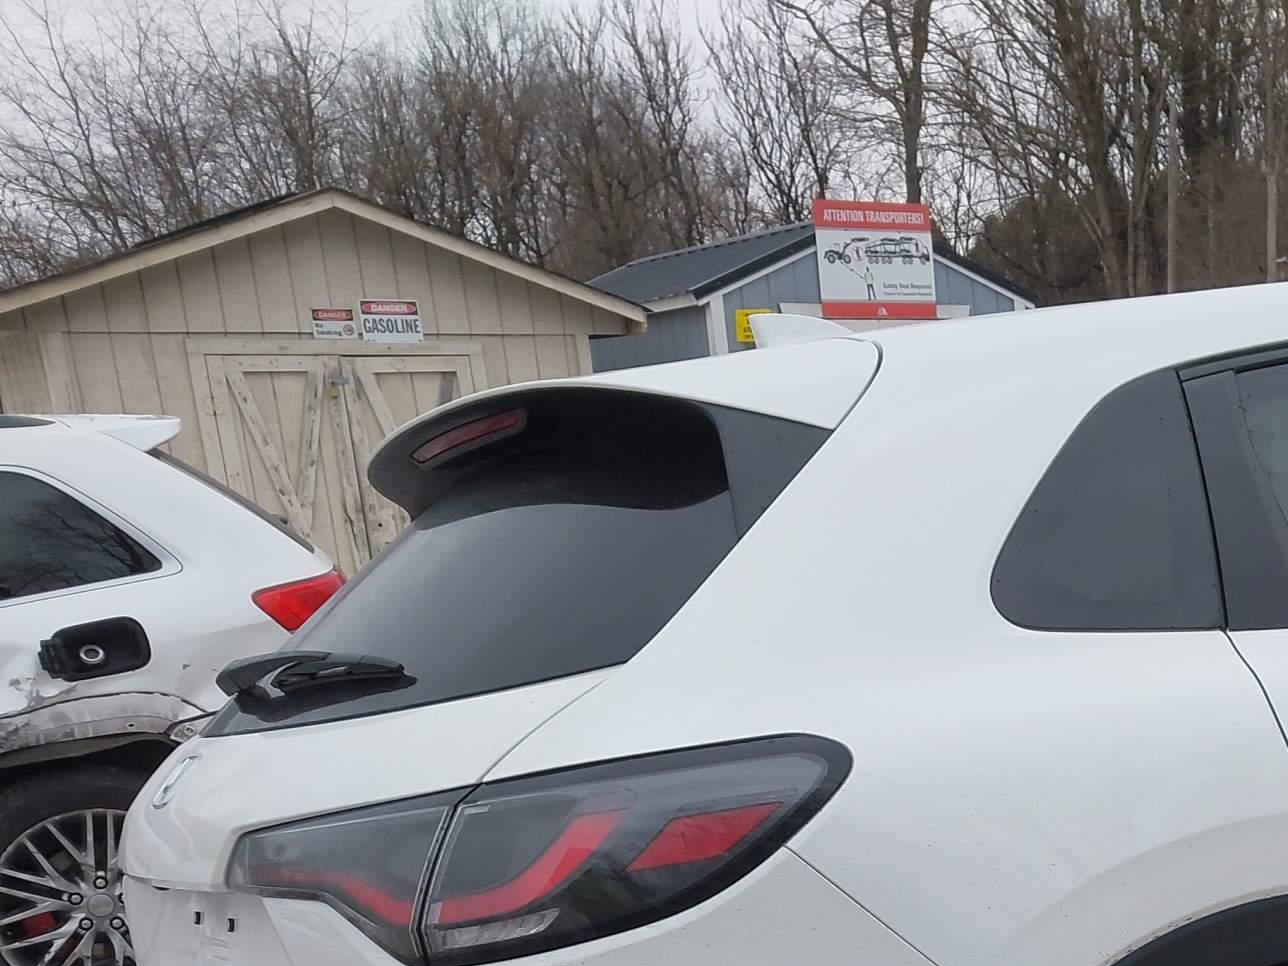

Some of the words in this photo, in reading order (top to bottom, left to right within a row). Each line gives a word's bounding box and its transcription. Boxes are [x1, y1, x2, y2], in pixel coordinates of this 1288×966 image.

[823, 209, 864, 222] ATTENTION
[865, 210, 924, 224] TRANSPORTERS!
[371, 304, 408, 313] DANGER
[363, 318, 421, 334] GASOLINE
